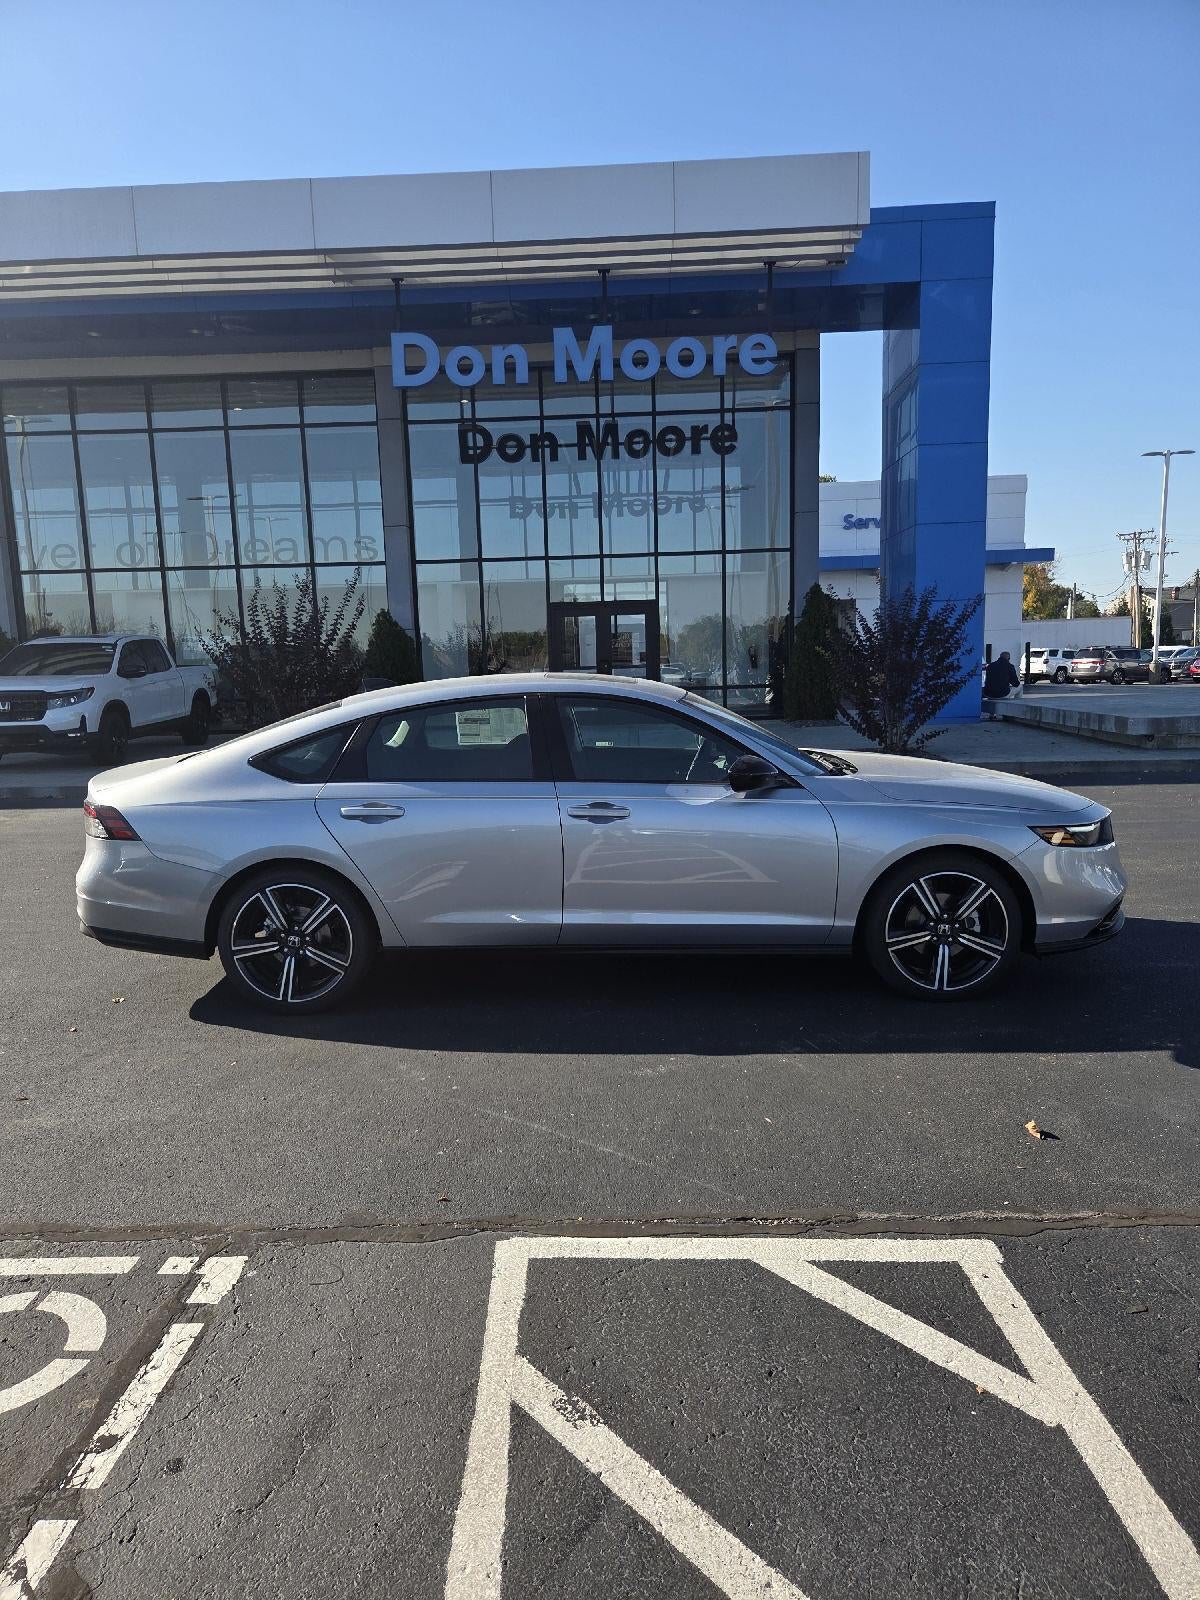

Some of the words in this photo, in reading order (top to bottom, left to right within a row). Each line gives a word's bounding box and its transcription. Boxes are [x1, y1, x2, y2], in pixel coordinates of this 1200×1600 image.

[391, 332, 529, 387] Don
[553, 324, 778, 383] Moore
[458, 423, 560, 464] Don
[576, 420, 738, 462] Moore
